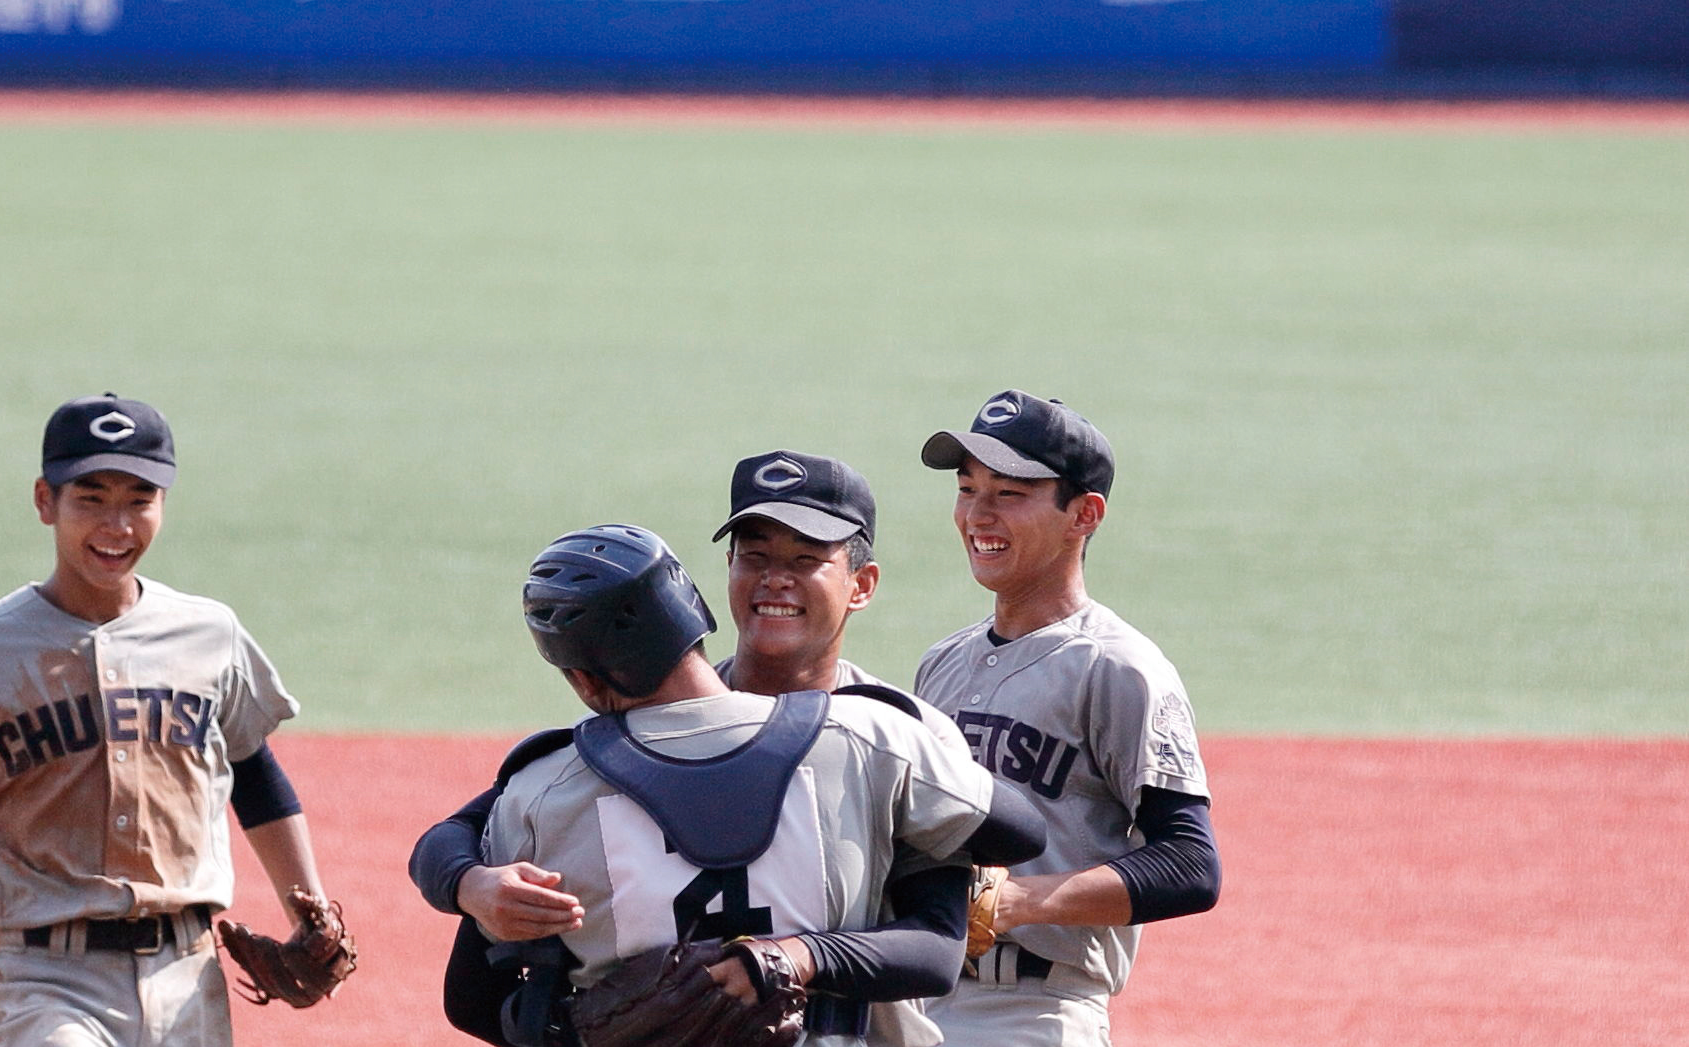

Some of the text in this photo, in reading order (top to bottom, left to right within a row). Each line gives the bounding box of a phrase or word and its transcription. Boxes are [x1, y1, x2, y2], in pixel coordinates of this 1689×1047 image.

[89, 410, 136, 443] C
[980, 399, 1018, 424] C
[754, 459, 804, 491] C
[950, 700, 1080, 800] ETSU
